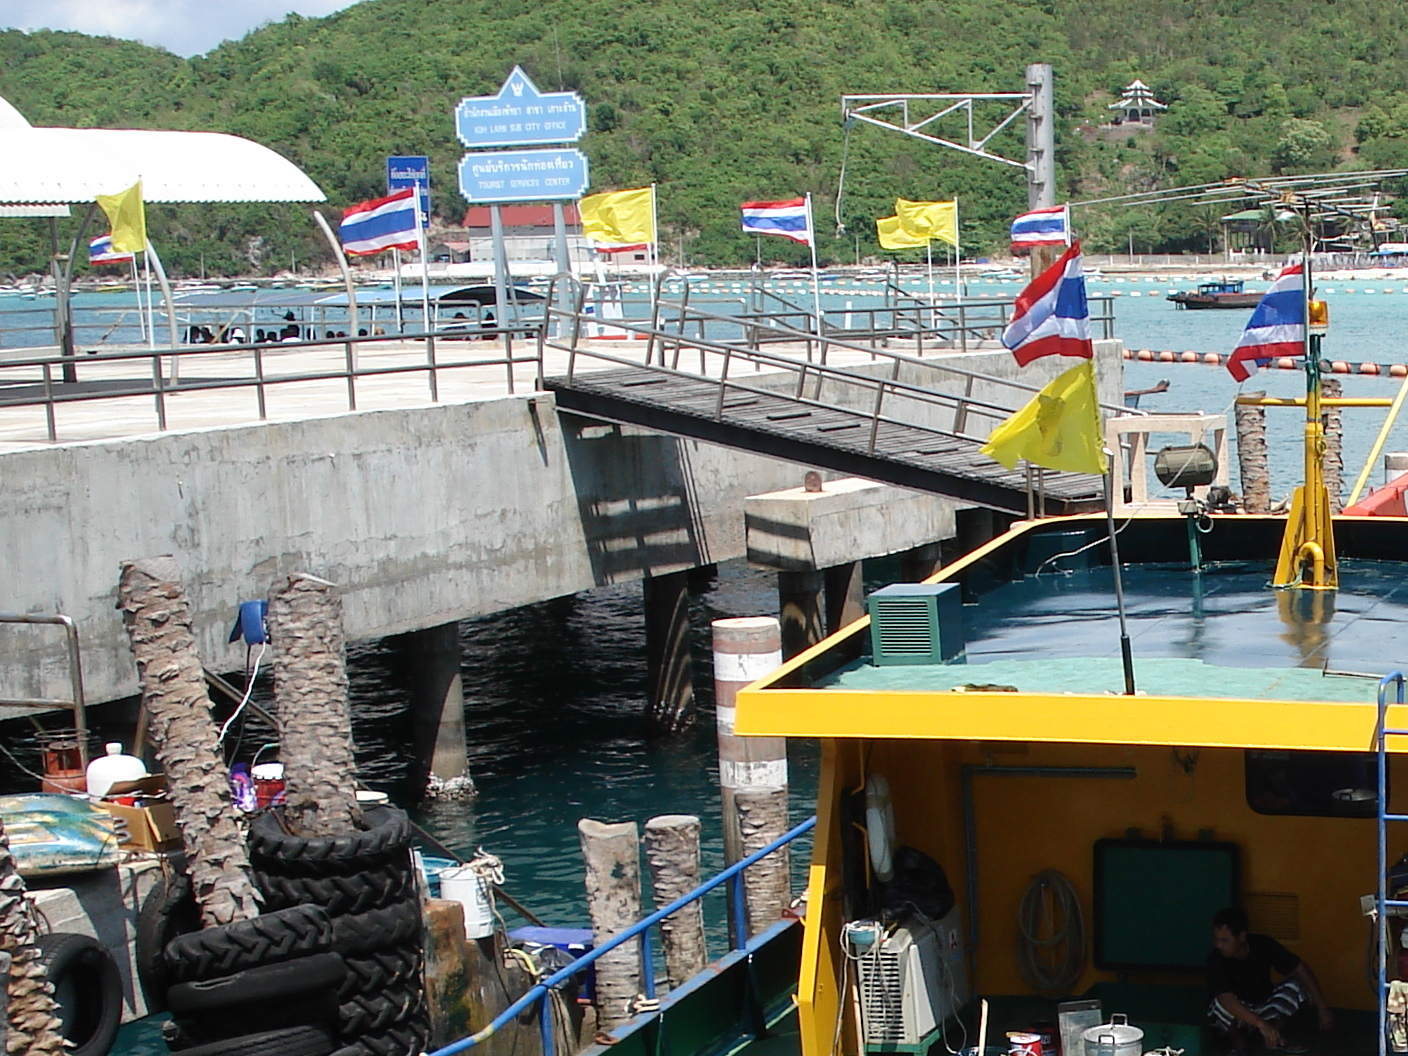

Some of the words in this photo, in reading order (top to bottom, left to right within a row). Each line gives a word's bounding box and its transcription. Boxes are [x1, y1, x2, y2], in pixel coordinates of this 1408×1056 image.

[474, 126, 487, 134] KOH
[490, 125, 507, 134] LARN
[510, 123, 523, 132] SUB
[525, 122, 541, 131] CITY
[544, 121, 567, 130] OFFICE
[472, 157, 574, 178] ศูนย์บริการนักท่องเที่ยว
[478, 180, 505, 190] TOURIST
[544, 177, 571, 187] CENTER
